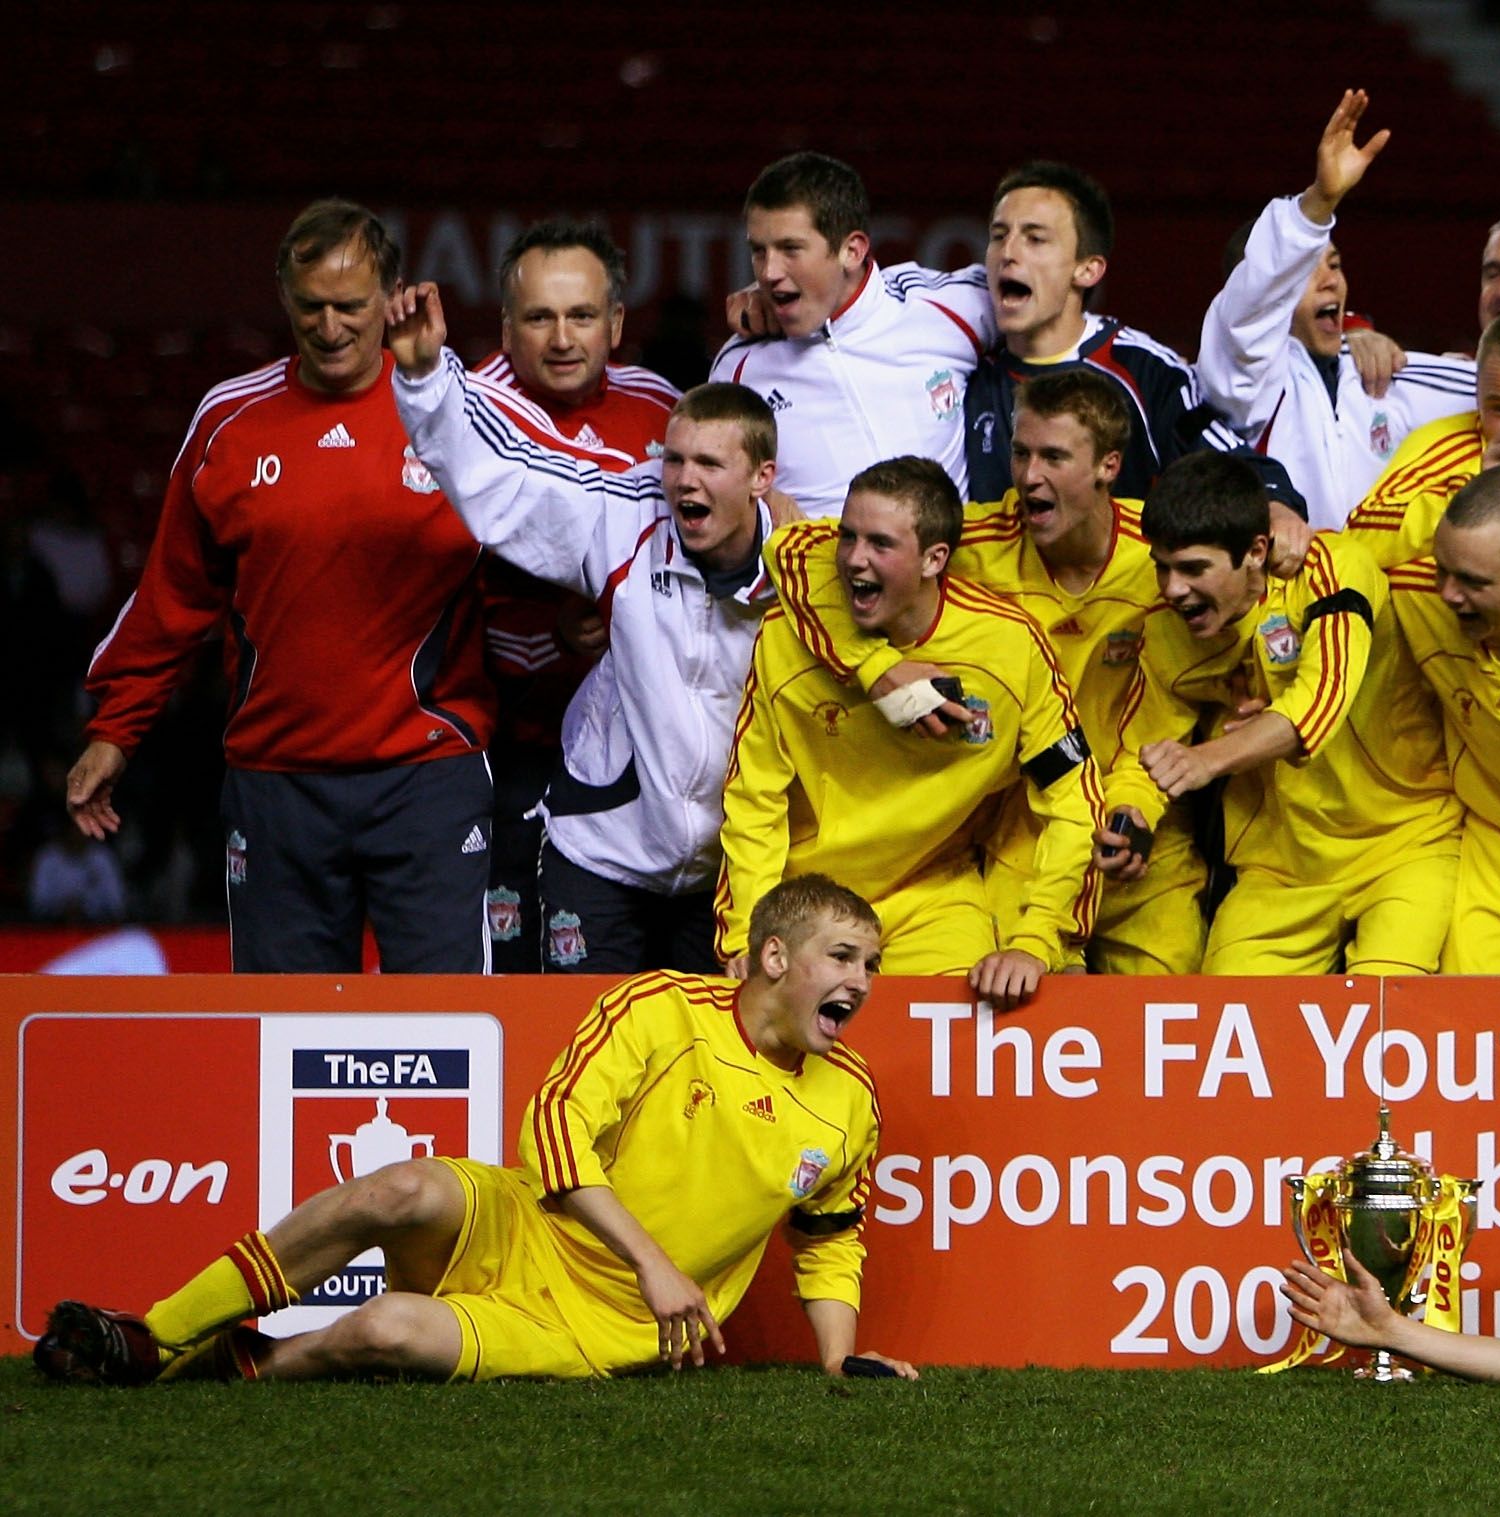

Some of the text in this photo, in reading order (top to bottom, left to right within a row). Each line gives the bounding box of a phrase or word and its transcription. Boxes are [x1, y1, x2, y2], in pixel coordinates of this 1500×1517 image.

[250, 454, 281, 488] JO
[909, 1002, 1102, 1098] The
[1143, 1002, 1272, 1098] FA
[874, 1130, 1433, 1252] sponsor
[1110, 1264, 1332, 1356] 200
